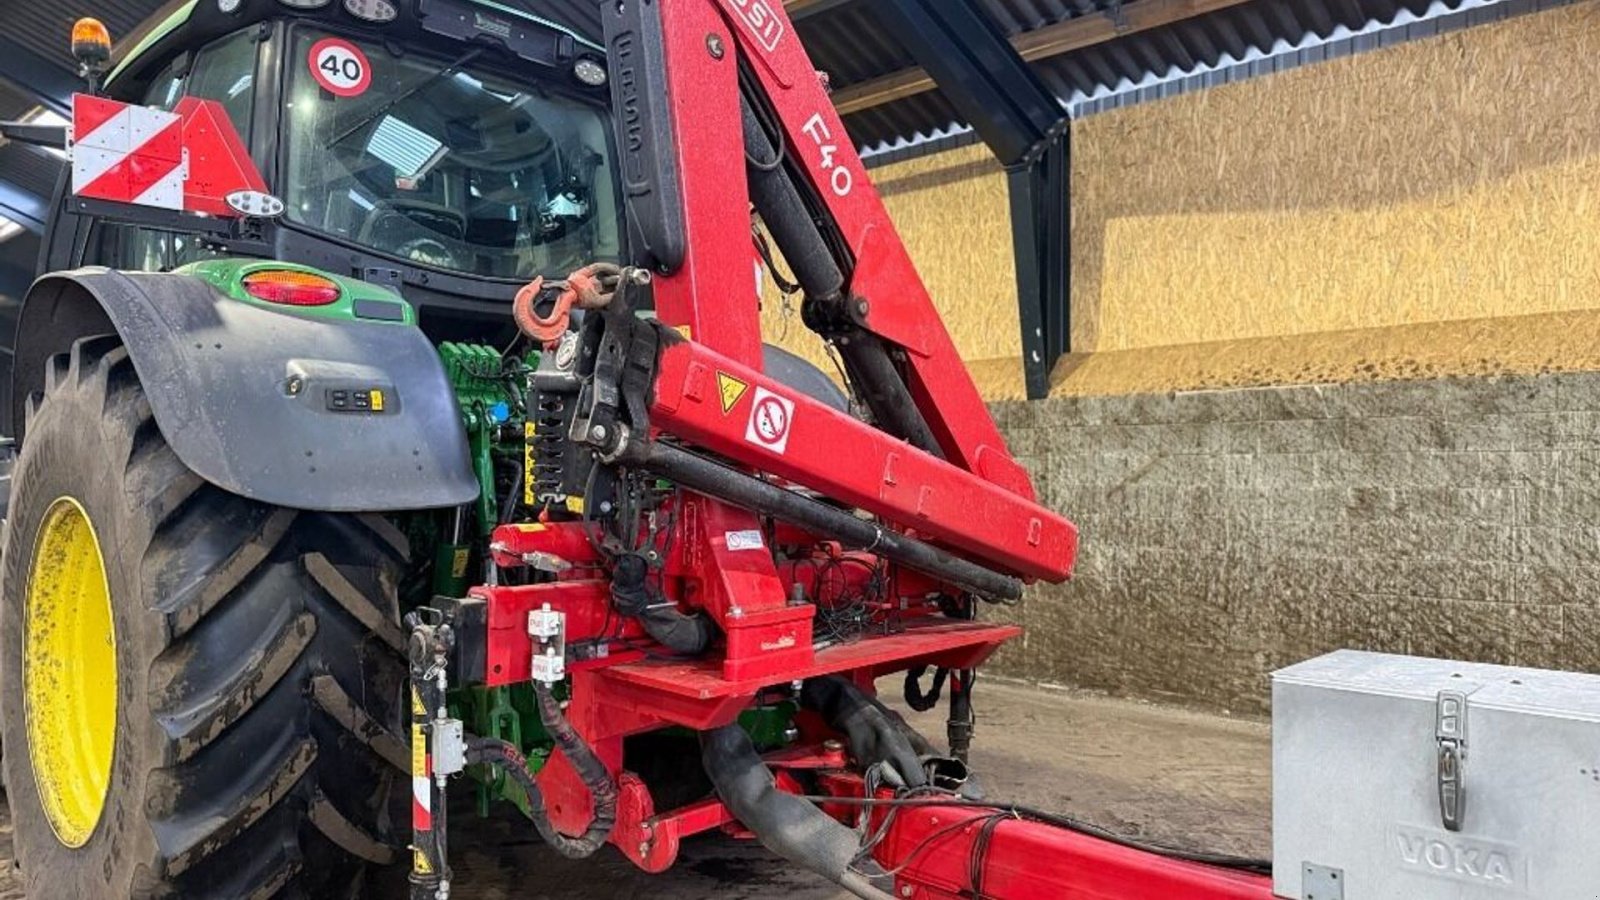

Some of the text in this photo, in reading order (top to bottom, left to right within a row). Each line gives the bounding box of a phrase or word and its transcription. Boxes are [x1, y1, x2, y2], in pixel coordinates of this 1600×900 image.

[321, 54, 361, 81] 40
[802, 112, 852, 197] F40
[1396, 833, 1514, 884] VOKA
